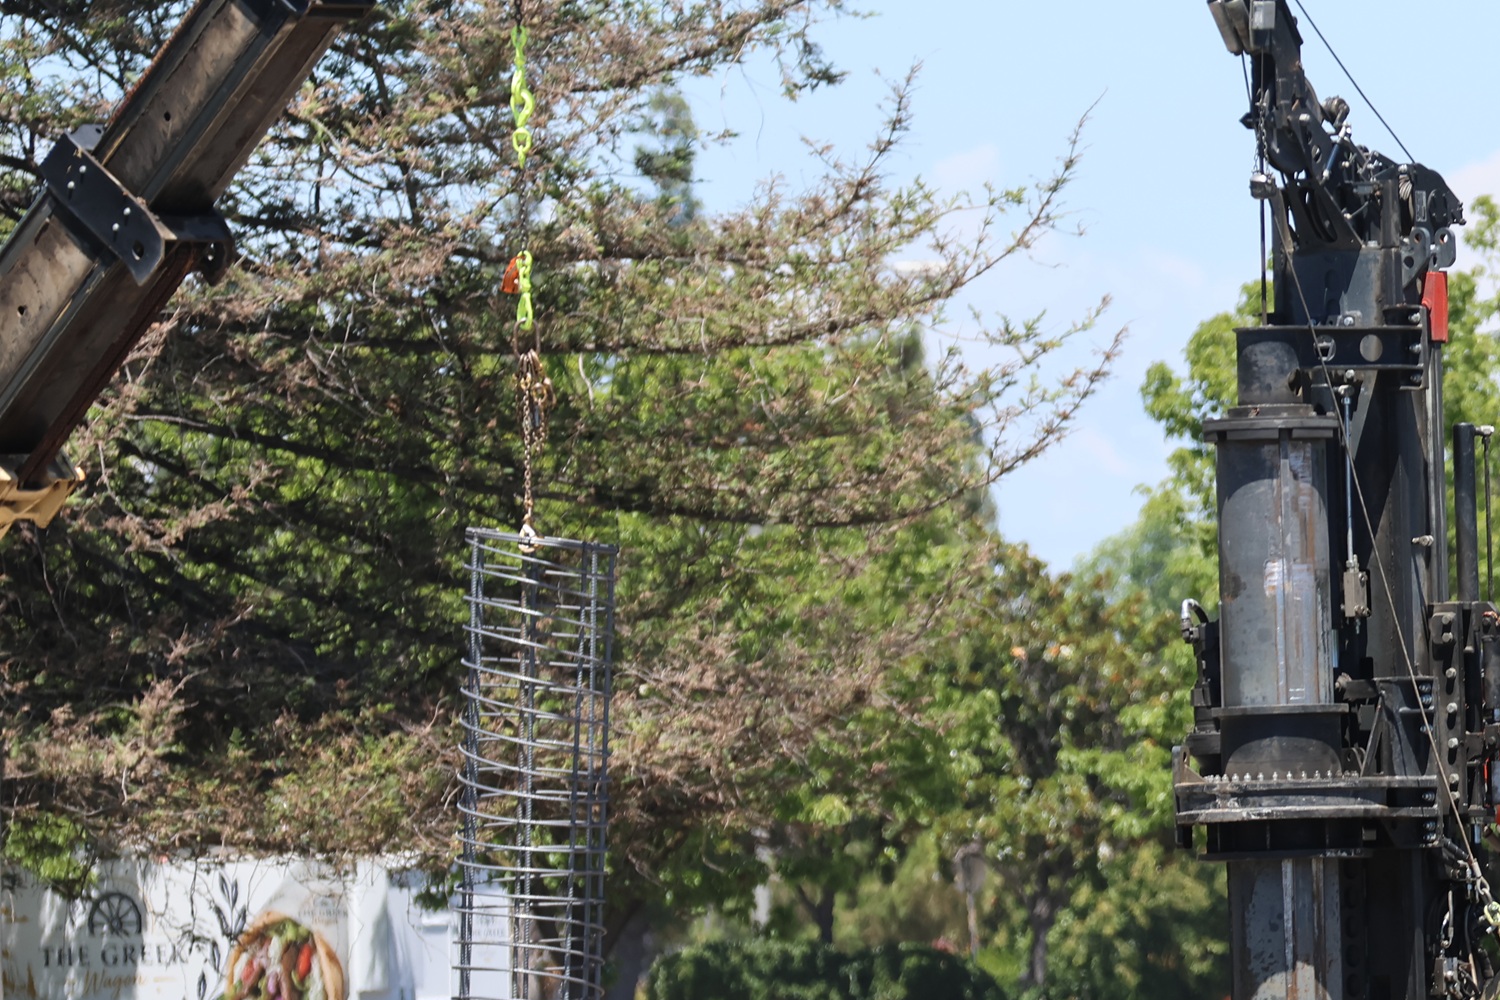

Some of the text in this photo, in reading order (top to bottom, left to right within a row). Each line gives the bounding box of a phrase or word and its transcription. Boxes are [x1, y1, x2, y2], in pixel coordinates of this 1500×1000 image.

[39, 944, 189, 968] THE GREEK
[82, 969, 146, 1000] Wagon
